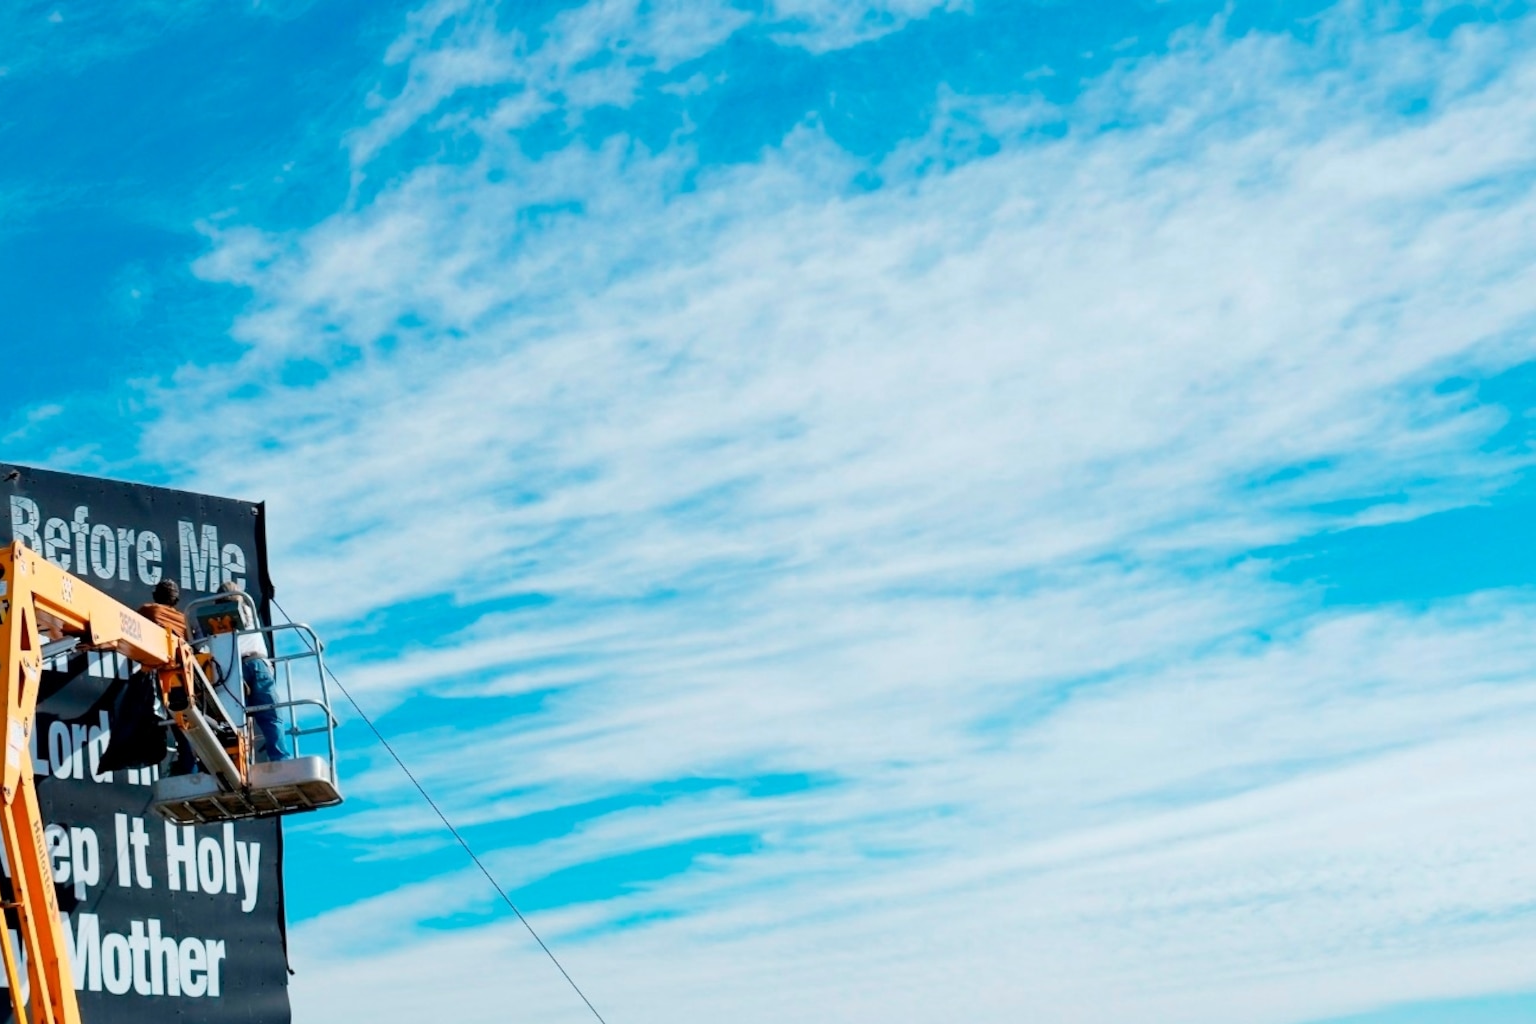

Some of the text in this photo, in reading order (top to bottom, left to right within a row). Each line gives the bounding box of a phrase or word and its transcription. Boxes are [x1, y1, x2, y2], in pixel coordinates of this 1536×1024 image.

[10, 497, 162, 586] Before
[178, 520, 247, 593] Me
[114, 812, 153, 890] It
[165, 820, 261, 913] Holy
[61, 911, 226, 999] Mother
